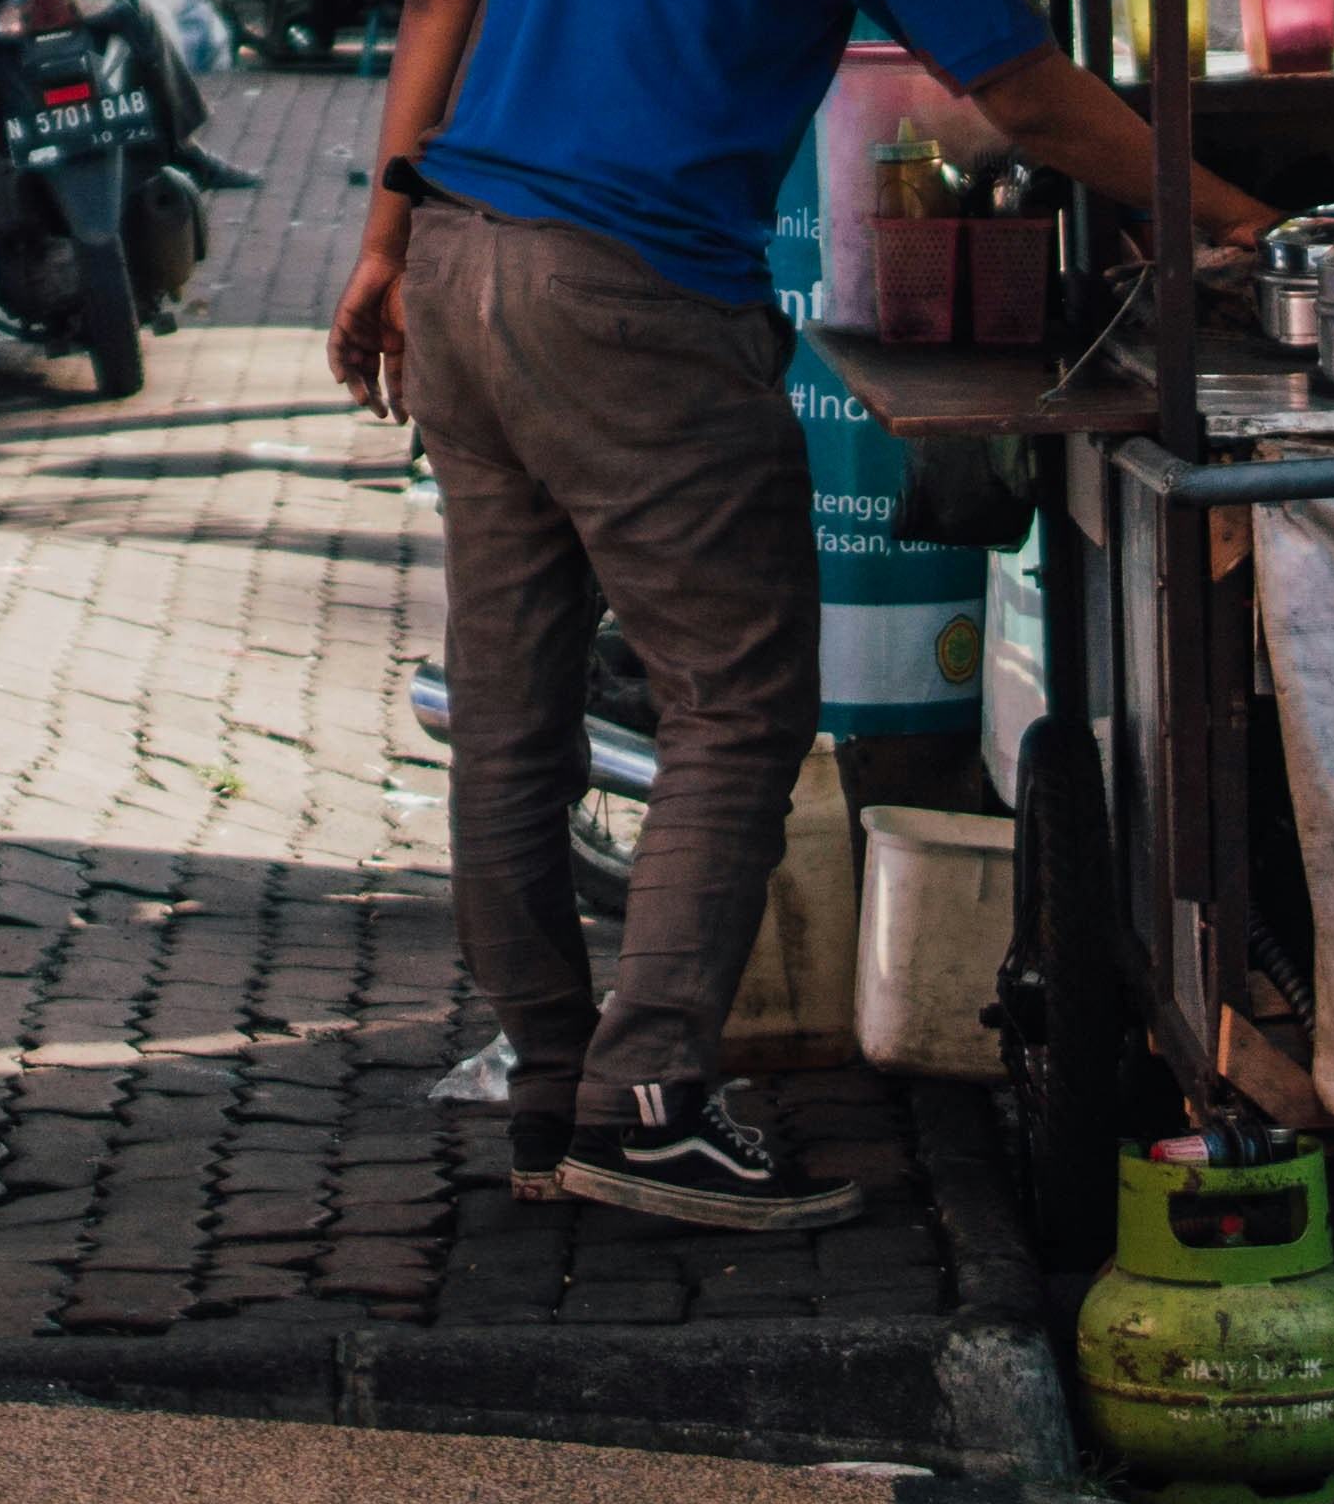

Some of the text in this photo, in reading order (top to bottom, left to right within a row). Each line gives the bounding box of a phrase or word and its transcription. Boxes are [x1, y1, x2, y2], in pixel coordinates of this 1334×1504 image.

[5, 90, 146, 139] N 5701 BAB
[813, 490, 896, 522] tengg
